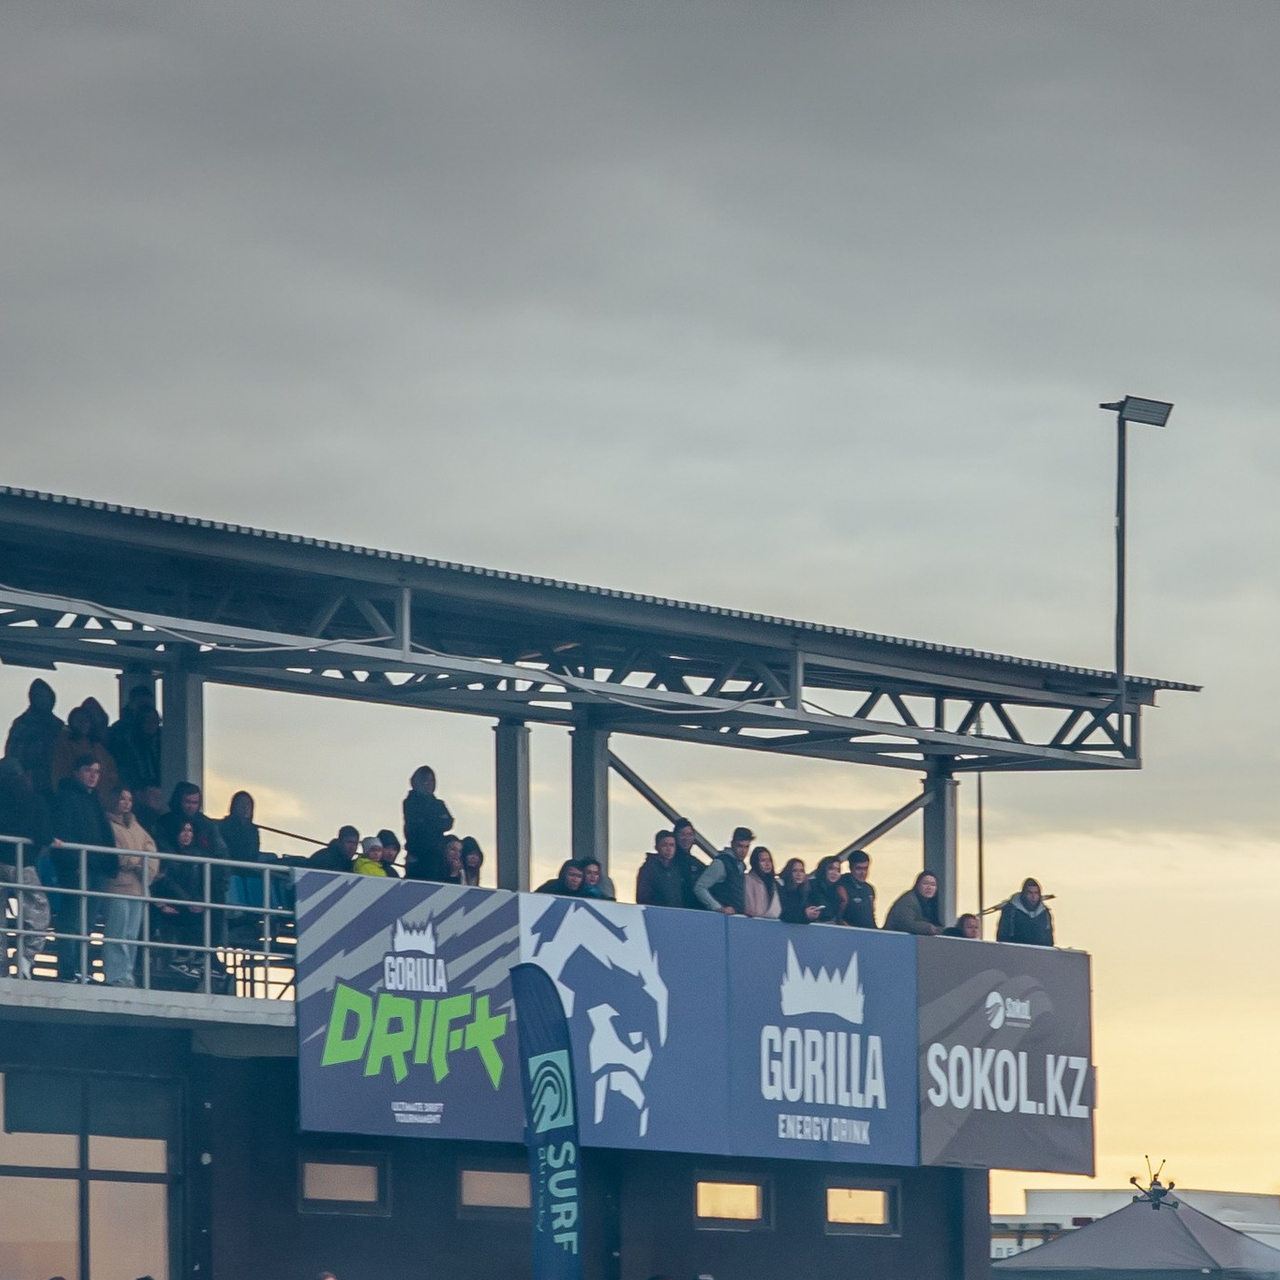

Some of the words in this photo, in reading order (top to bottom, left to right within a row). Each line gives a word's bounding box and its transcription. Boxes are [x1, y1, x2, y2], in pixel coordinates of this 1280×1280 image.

[384, 956, 447, 993] GORILLA
[321, 983, 508, 1091] DRIFT
[760, 1025, 886, 1109] GORILLA
[927, 1043, 1089, 1118] SOKOL.KZ
[778, 1114, 829, 1142] ENERGY
[831, 1118, 871, 1145] DRINK
[547, 1141, 578, 1255] SURF
